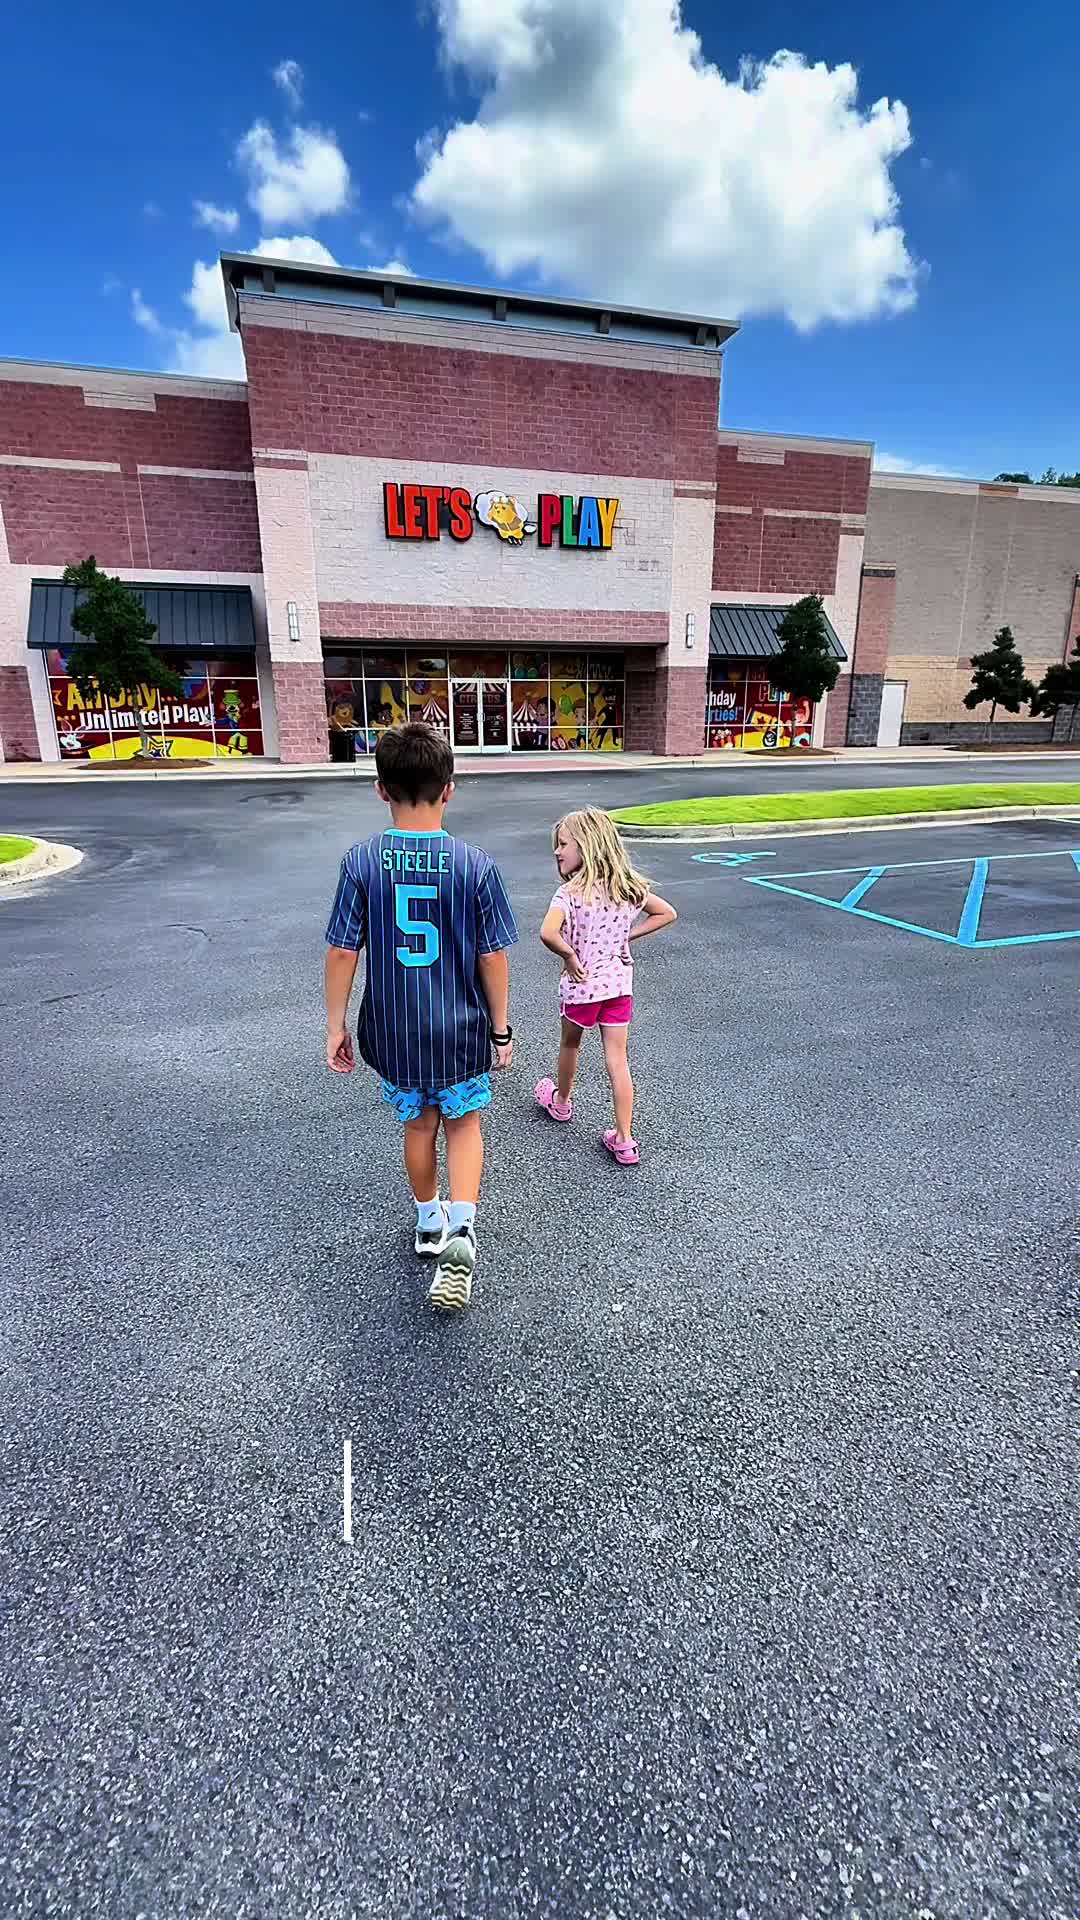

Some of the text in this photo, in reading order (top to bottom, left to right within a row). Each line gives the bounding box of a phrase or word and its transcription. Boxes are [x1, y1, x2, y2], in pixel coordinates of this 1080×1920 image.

[384, 483, 619, 549] LET'S PLAY
[382, 848, 450, 873] STEELE
[395, 883, 439, 967] 5
